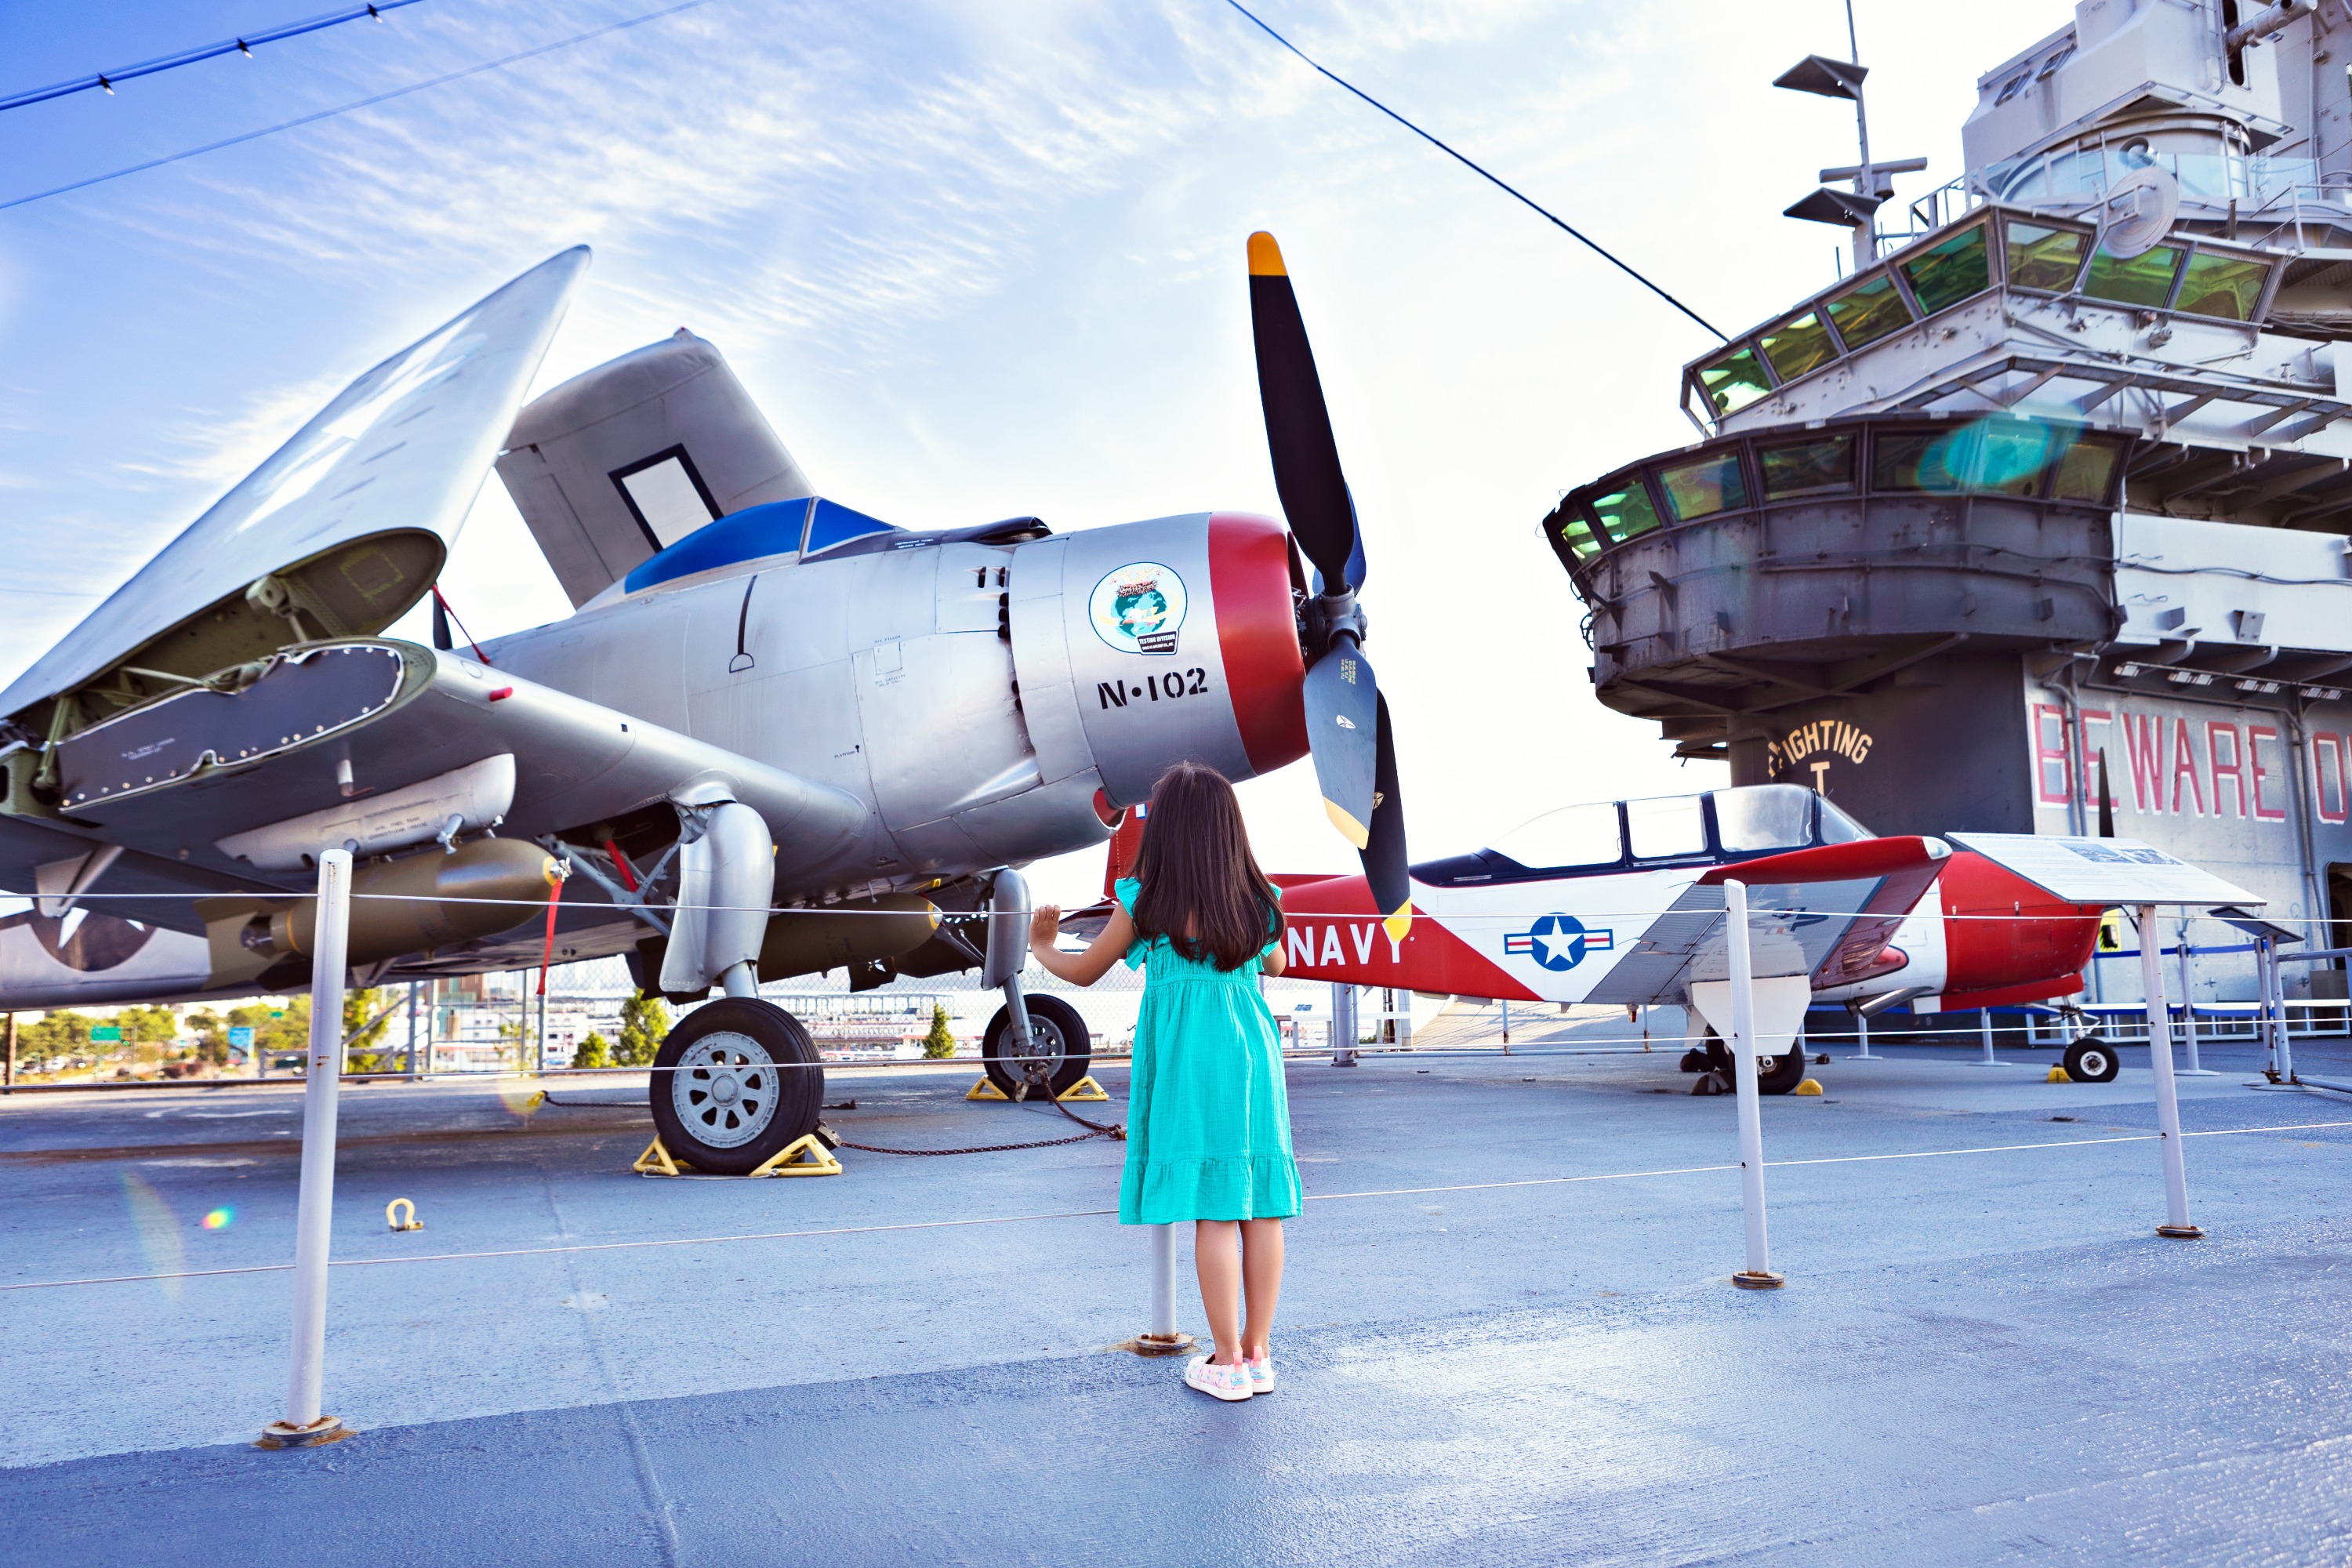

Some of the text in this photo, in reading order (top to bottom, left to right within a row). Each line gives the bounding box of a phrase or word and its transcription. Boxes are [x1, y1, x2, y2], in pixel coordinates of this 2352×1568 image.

[1138, 633, 1176, 644] TESTING DIVISION
[2032, 702, 2286, 824] BEWARE
